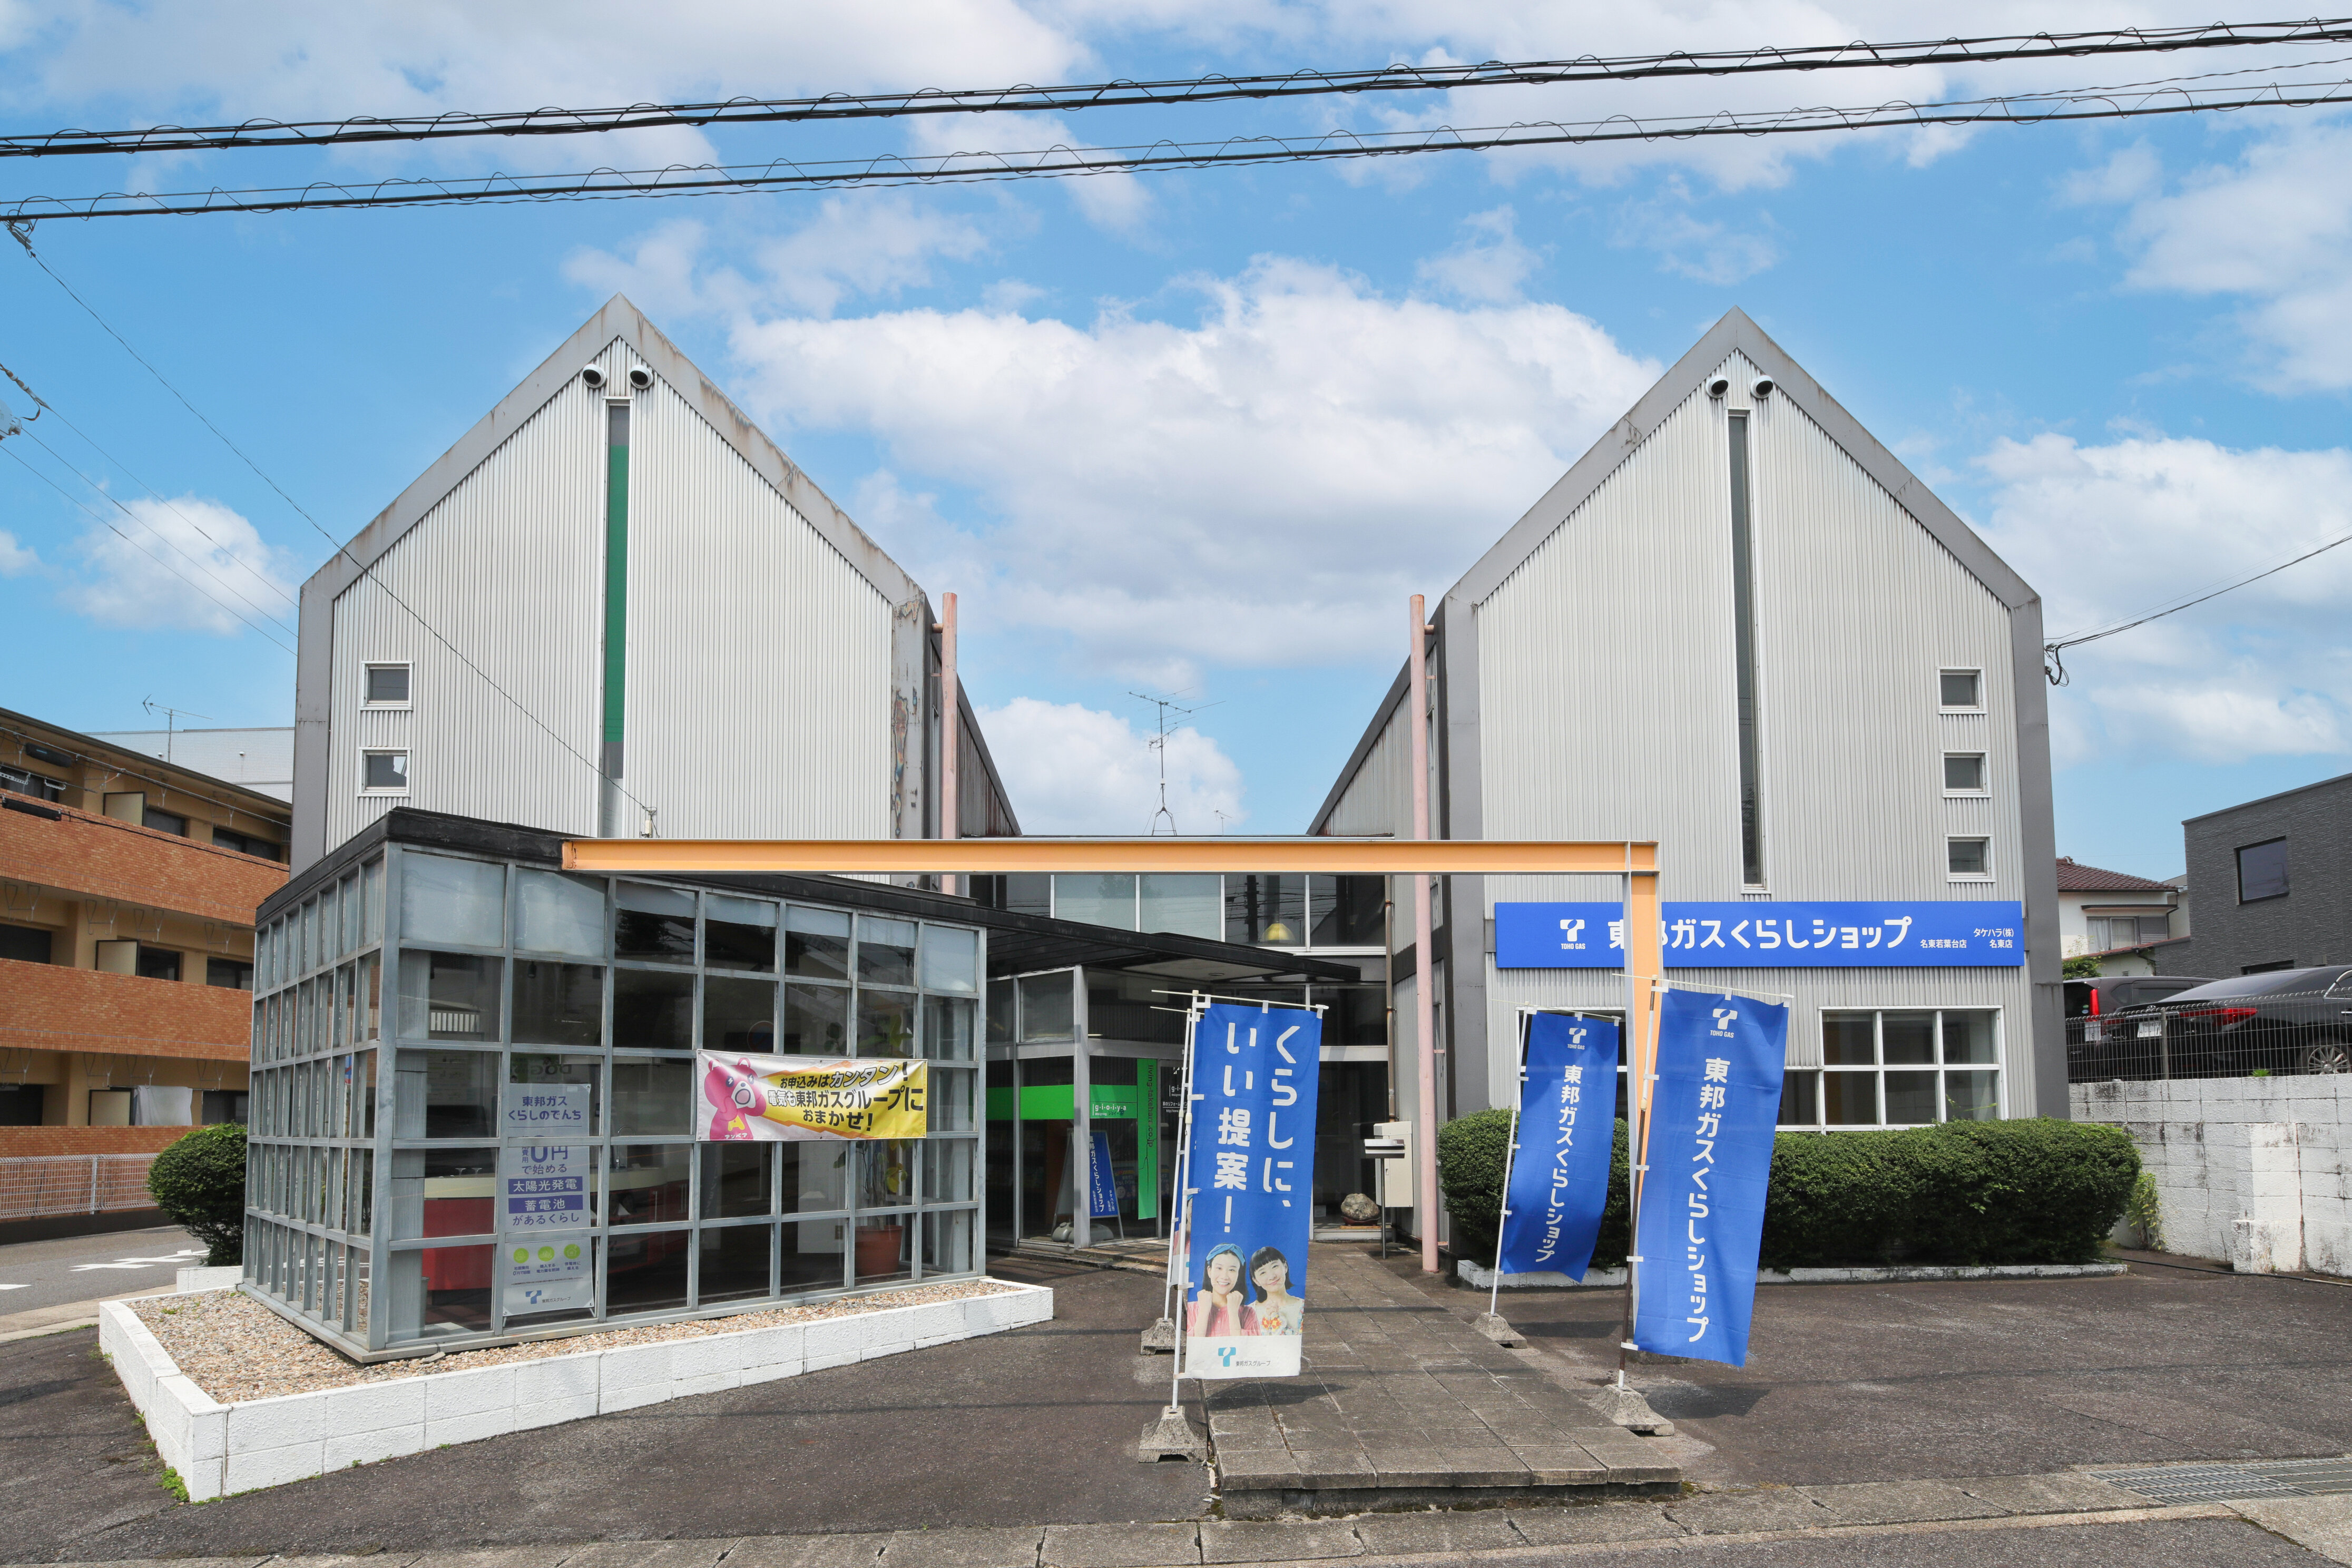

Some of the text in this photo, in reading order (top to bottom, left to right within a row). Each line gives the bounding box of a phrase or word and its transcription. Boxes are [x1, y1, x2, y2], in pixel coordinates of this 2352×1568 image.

[1608, 916, 1912, 949] 東ガスくらしショップ
[1920, 939, 1967, 948] 名東若葉台店
[1989, 939, 2013, 948] 名東店
[780, 1061, 908, 1089] お申込みはカンタン！
[522, 1096, 567, 1106] 東邦ガス
[768, 1087, 924, 1112] 電気も東邦ガスグループに
[508, 1110, 582, 1121] くらしのでんち
[802, 1109, 873, 1131] おまかせ！
[1262, 1025, 1300, 1208] くらしに、
[1213, 1022, 1257, 1233] いい提案！
[522, 1163, 567, 1174] で始める
[1535, 1064, 1583, 1262] 東邦ガスくらしショップ
[513, 1178, 577, 1192] 太陽光発電
[525, 1198, 565, 1211] 蓄電池
[1686, 1057, 1731, 1343] 東邦ガスくらしショップ
[513, 1213, 580, 1226] があるくらし
